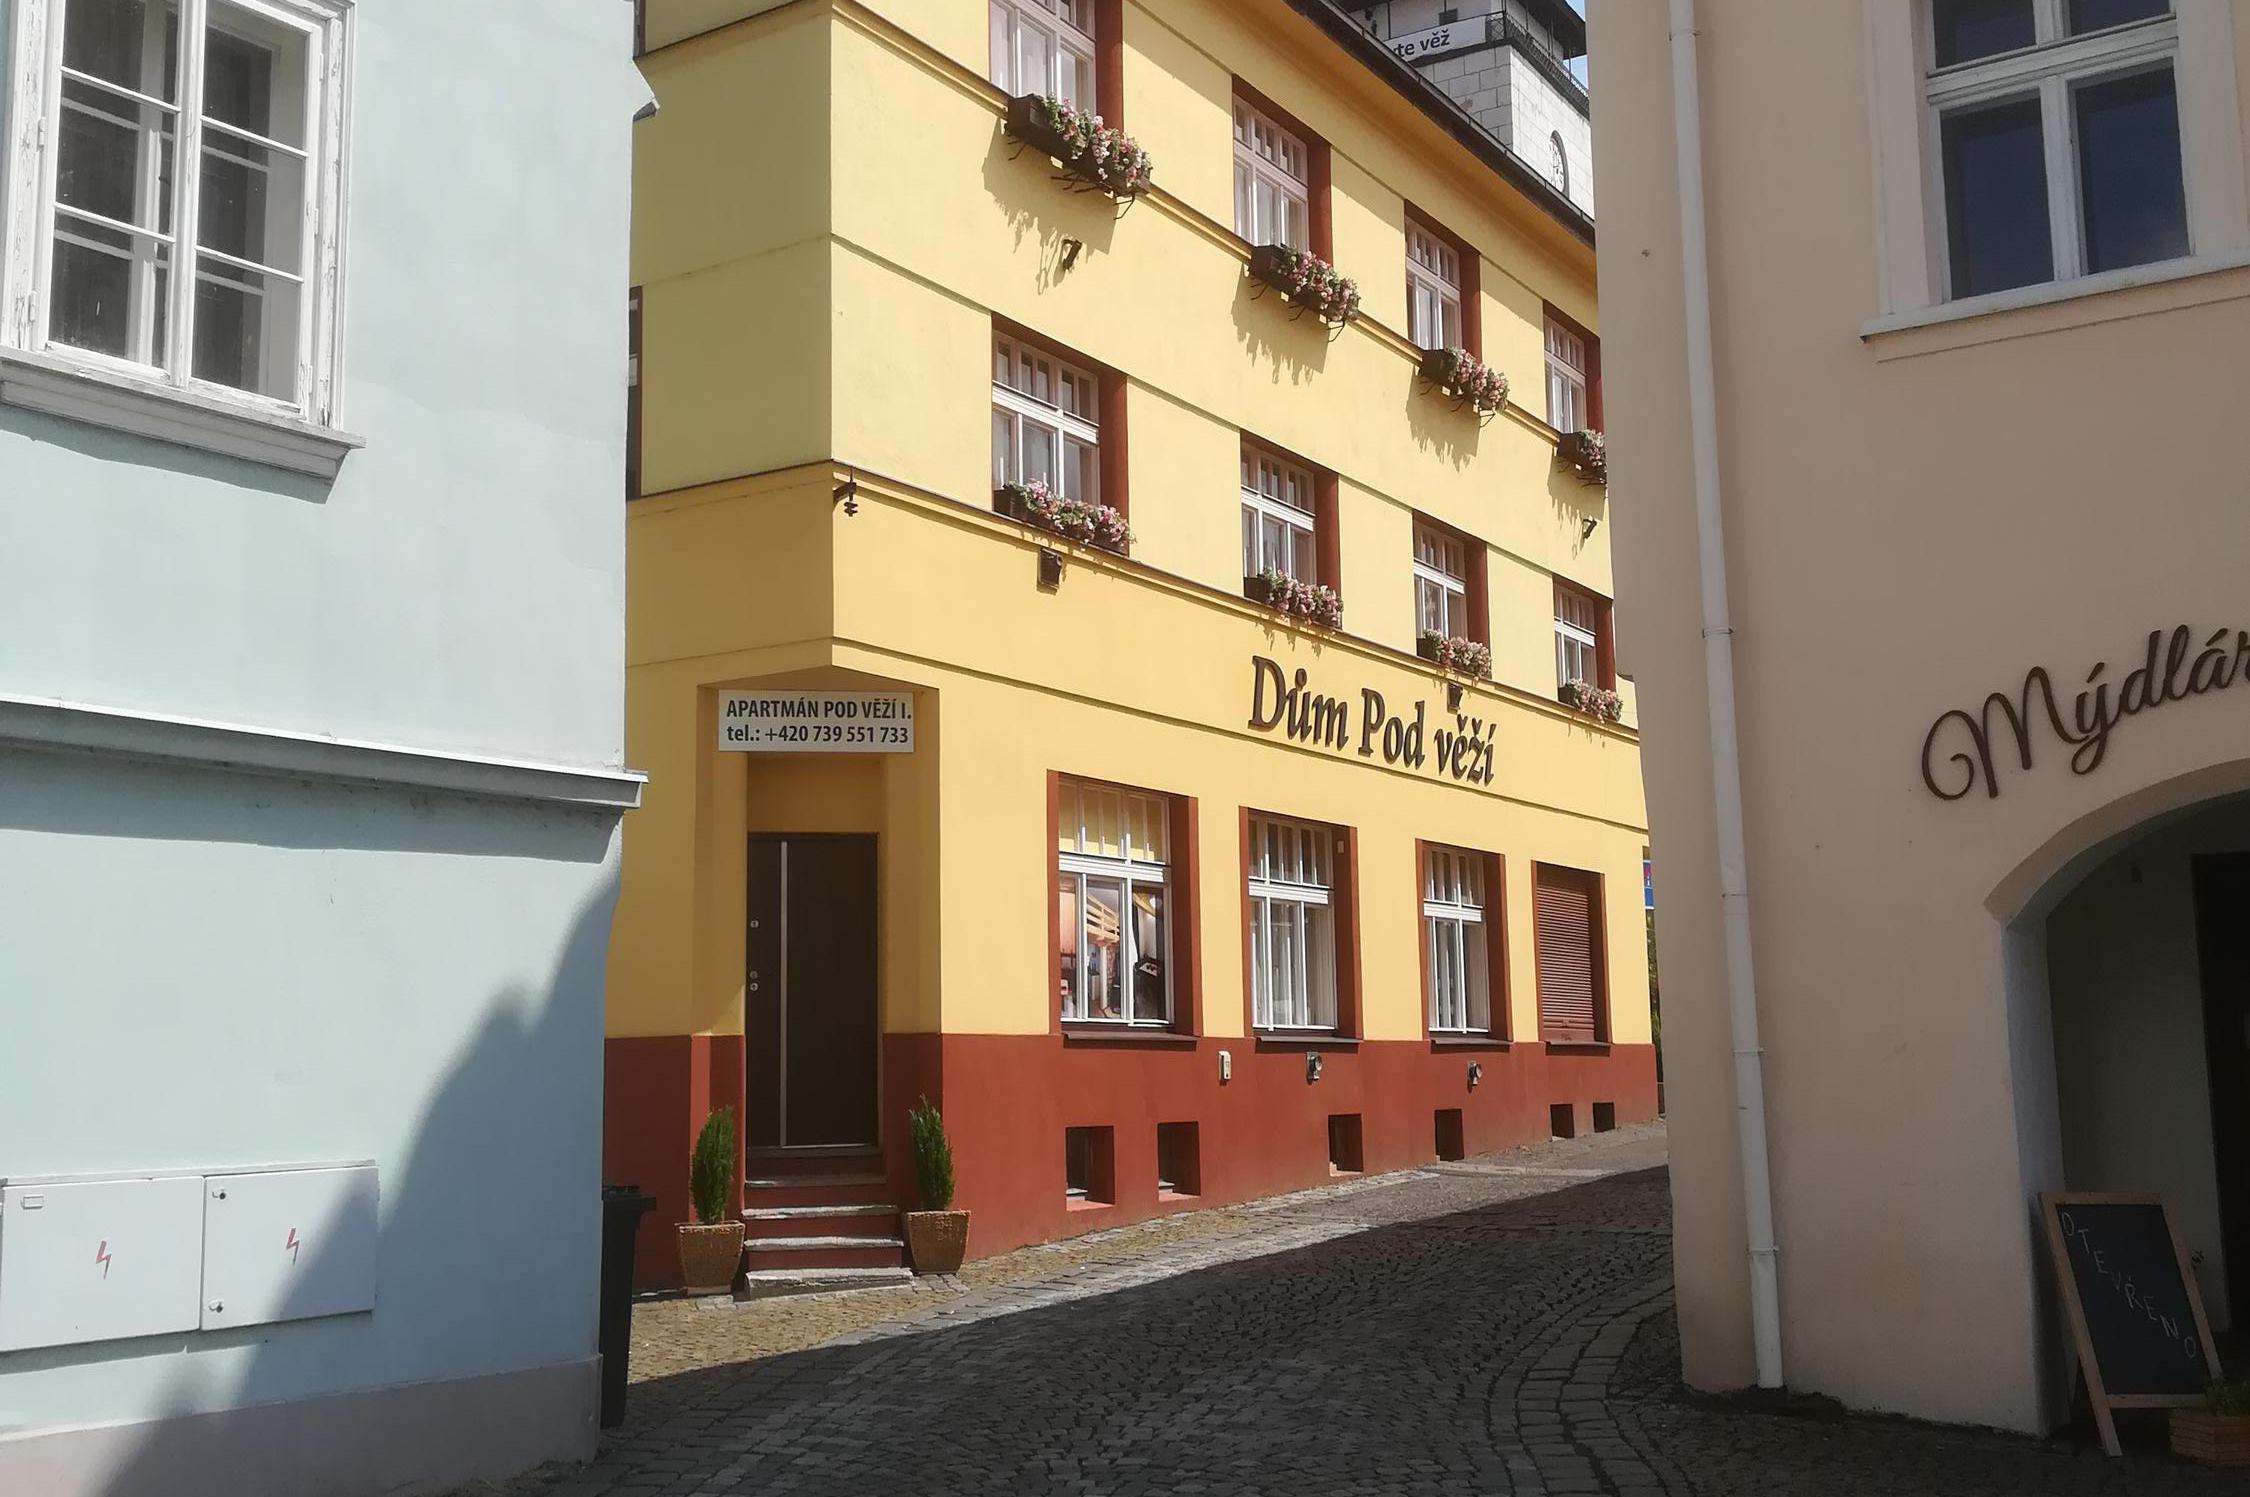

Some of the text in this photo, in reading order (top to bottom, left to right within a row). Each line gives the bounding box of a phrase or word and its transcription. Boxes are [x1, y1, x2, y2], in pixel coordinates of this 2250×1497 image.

[1393, 29, 1450, 57] te věž
[726, 697, 819, 718] APARTMÁN
[824, 700, 858, 719] POD
[862, 698, 897, 719] VĚŽÍ
[726, 724, 908, 743] tel.: +420 739 551 733
[1247, 655, 1497, 787] Dům Pod věží
